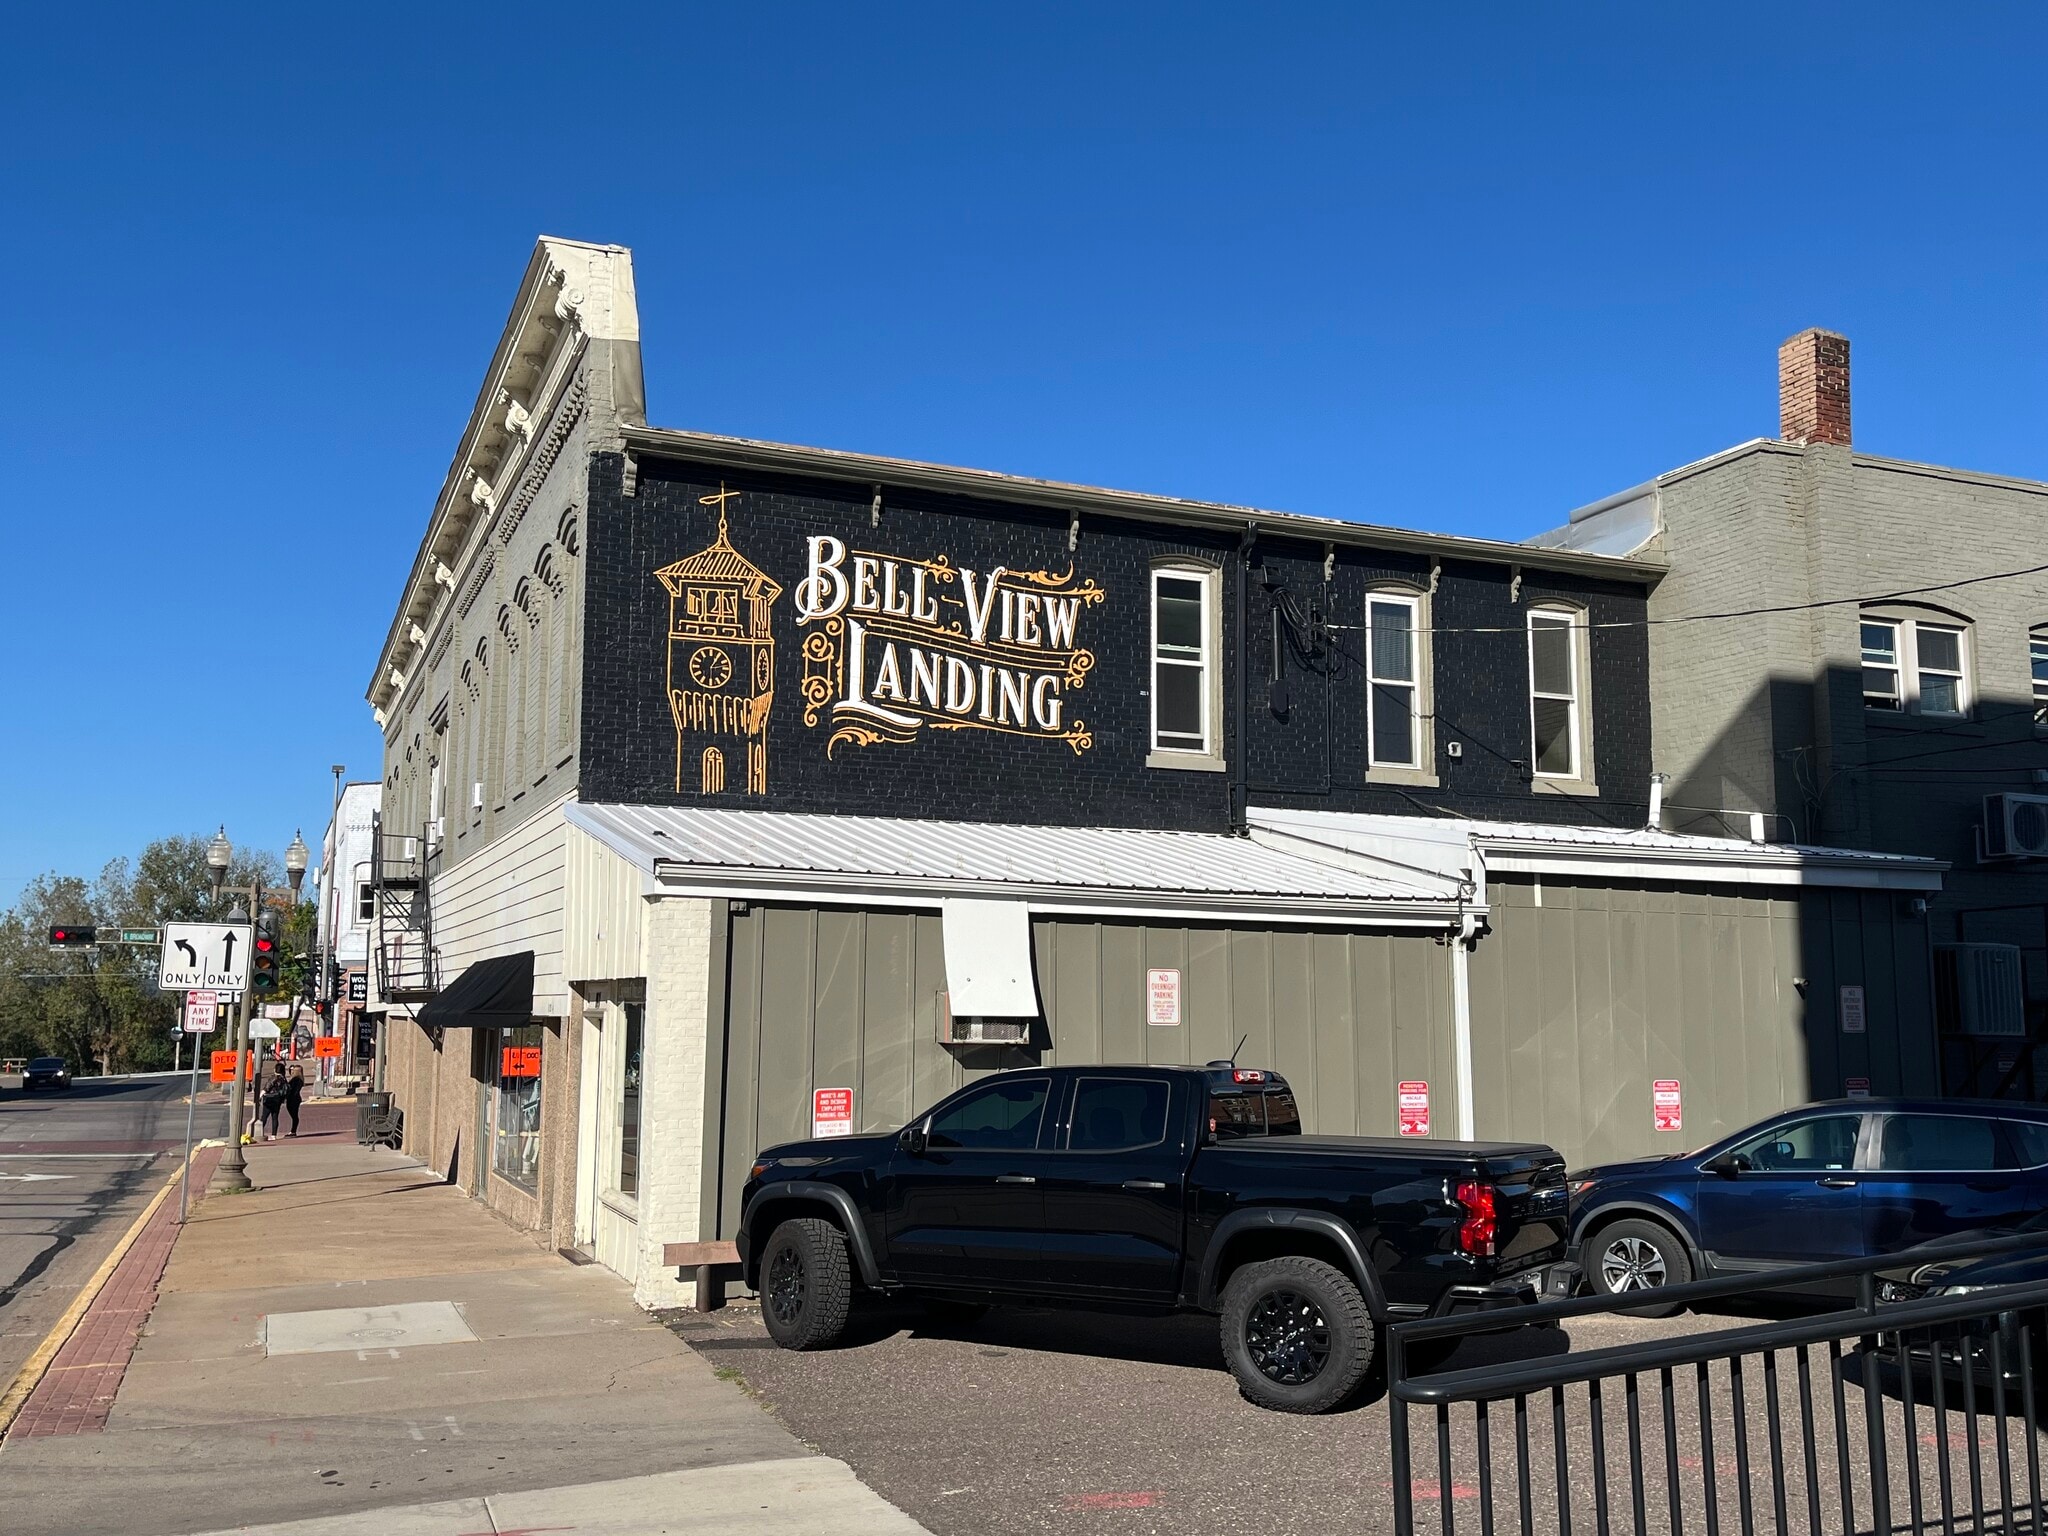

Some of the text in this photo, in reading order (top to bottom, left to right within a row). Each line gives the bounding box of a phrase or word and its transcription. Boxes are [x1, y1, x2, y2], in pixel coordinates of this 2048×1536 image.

[795, 535, 1082, 650] BELL VIEW
[832, 617, 1063, 731] LANDING
[165, 973, 243, 985] ONLY ONLY
[1158, 974, 1169, 982] NO
[192, 1007, 210, 1015] ANY
[191, 1017, 210, 1025] TIME
[214, 1055, 249, 1064] DETO
